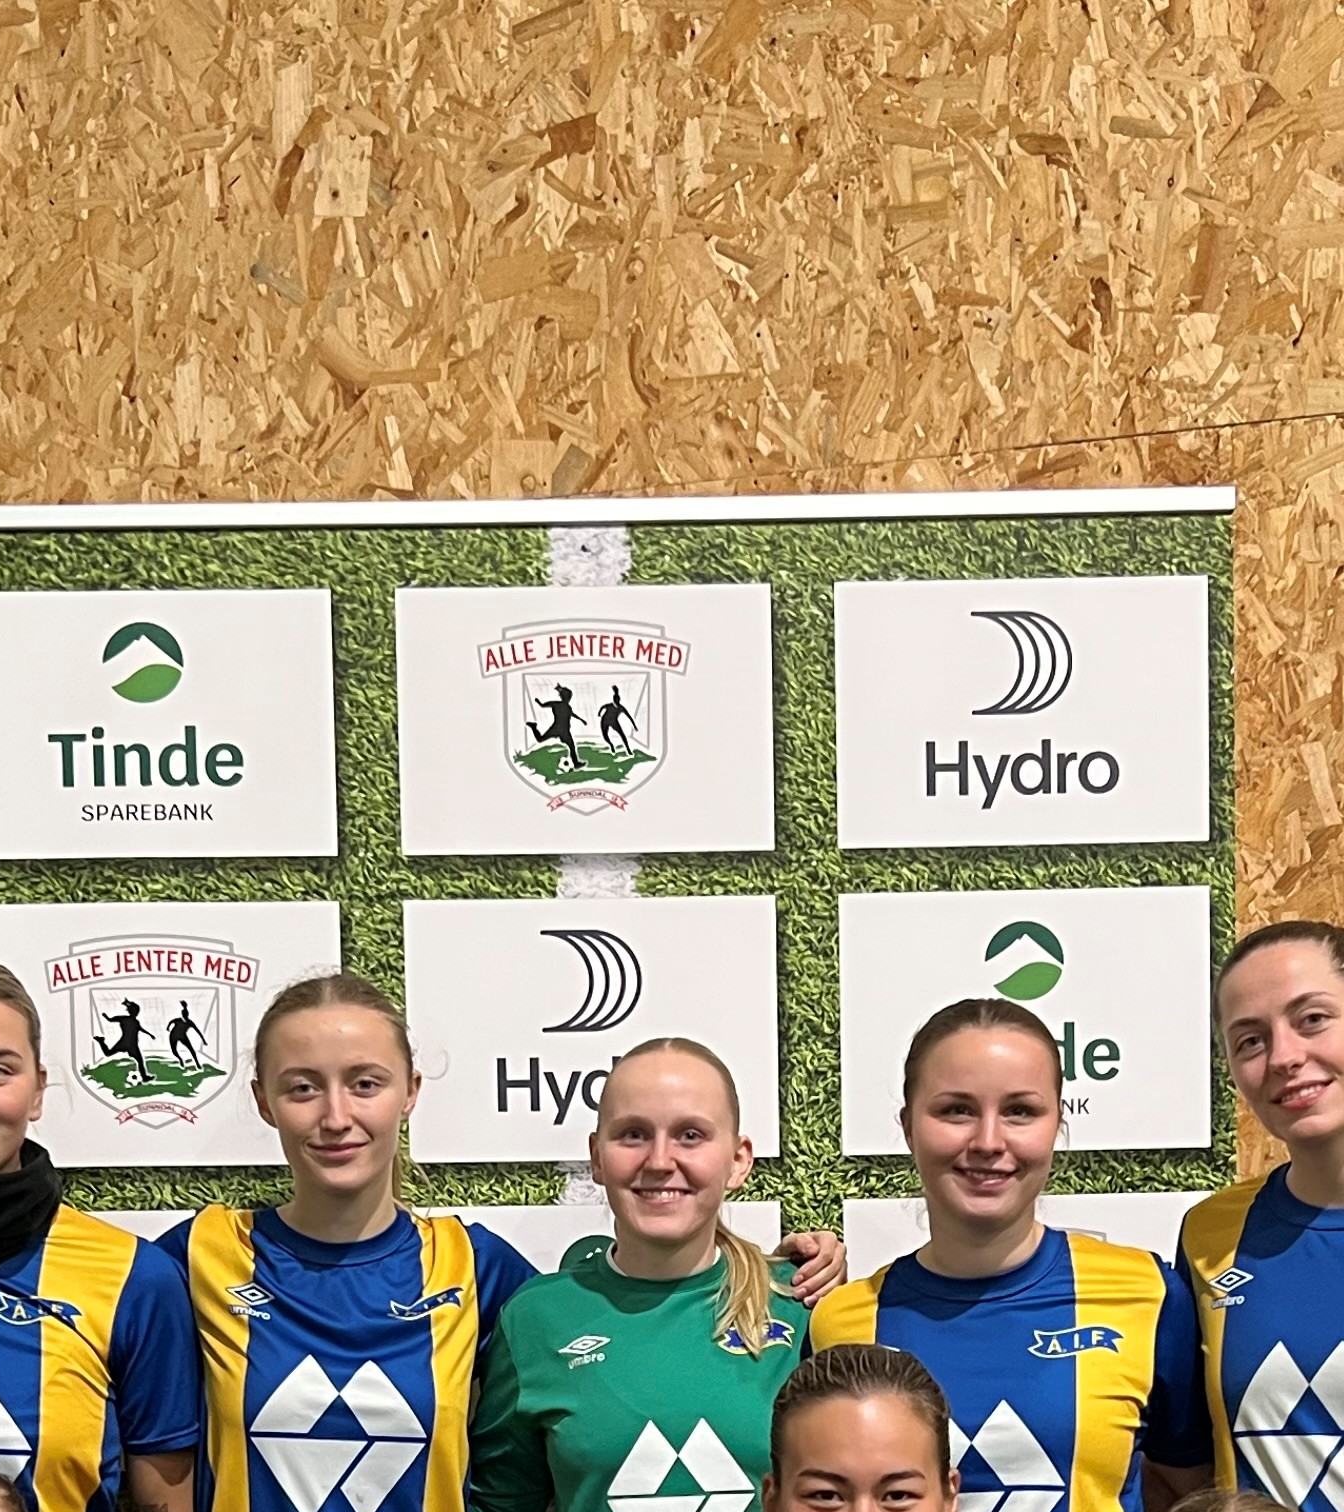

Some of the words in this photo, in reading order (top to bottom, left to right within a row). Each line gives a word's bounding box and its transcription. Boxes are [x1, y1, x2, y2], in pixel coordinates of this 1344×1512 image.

[485, 639, 537, 672] ALLE
[546, 634, 625, 659] JENTER
[636, 638, 683, 668] MED
[48, 725, 244, 788] Tinde
[926, 739, 1120, 810] Hydro
[81, 804, 214, 822] SPAREBANK
[52, 955, 104, 987] ALLE
[113, 949, 194, 975] JENTER
[204, 954, 252, 984] MED
[229, 1305, 272, 1321] umbro
[567, 1352, 606, 1370] umbro
